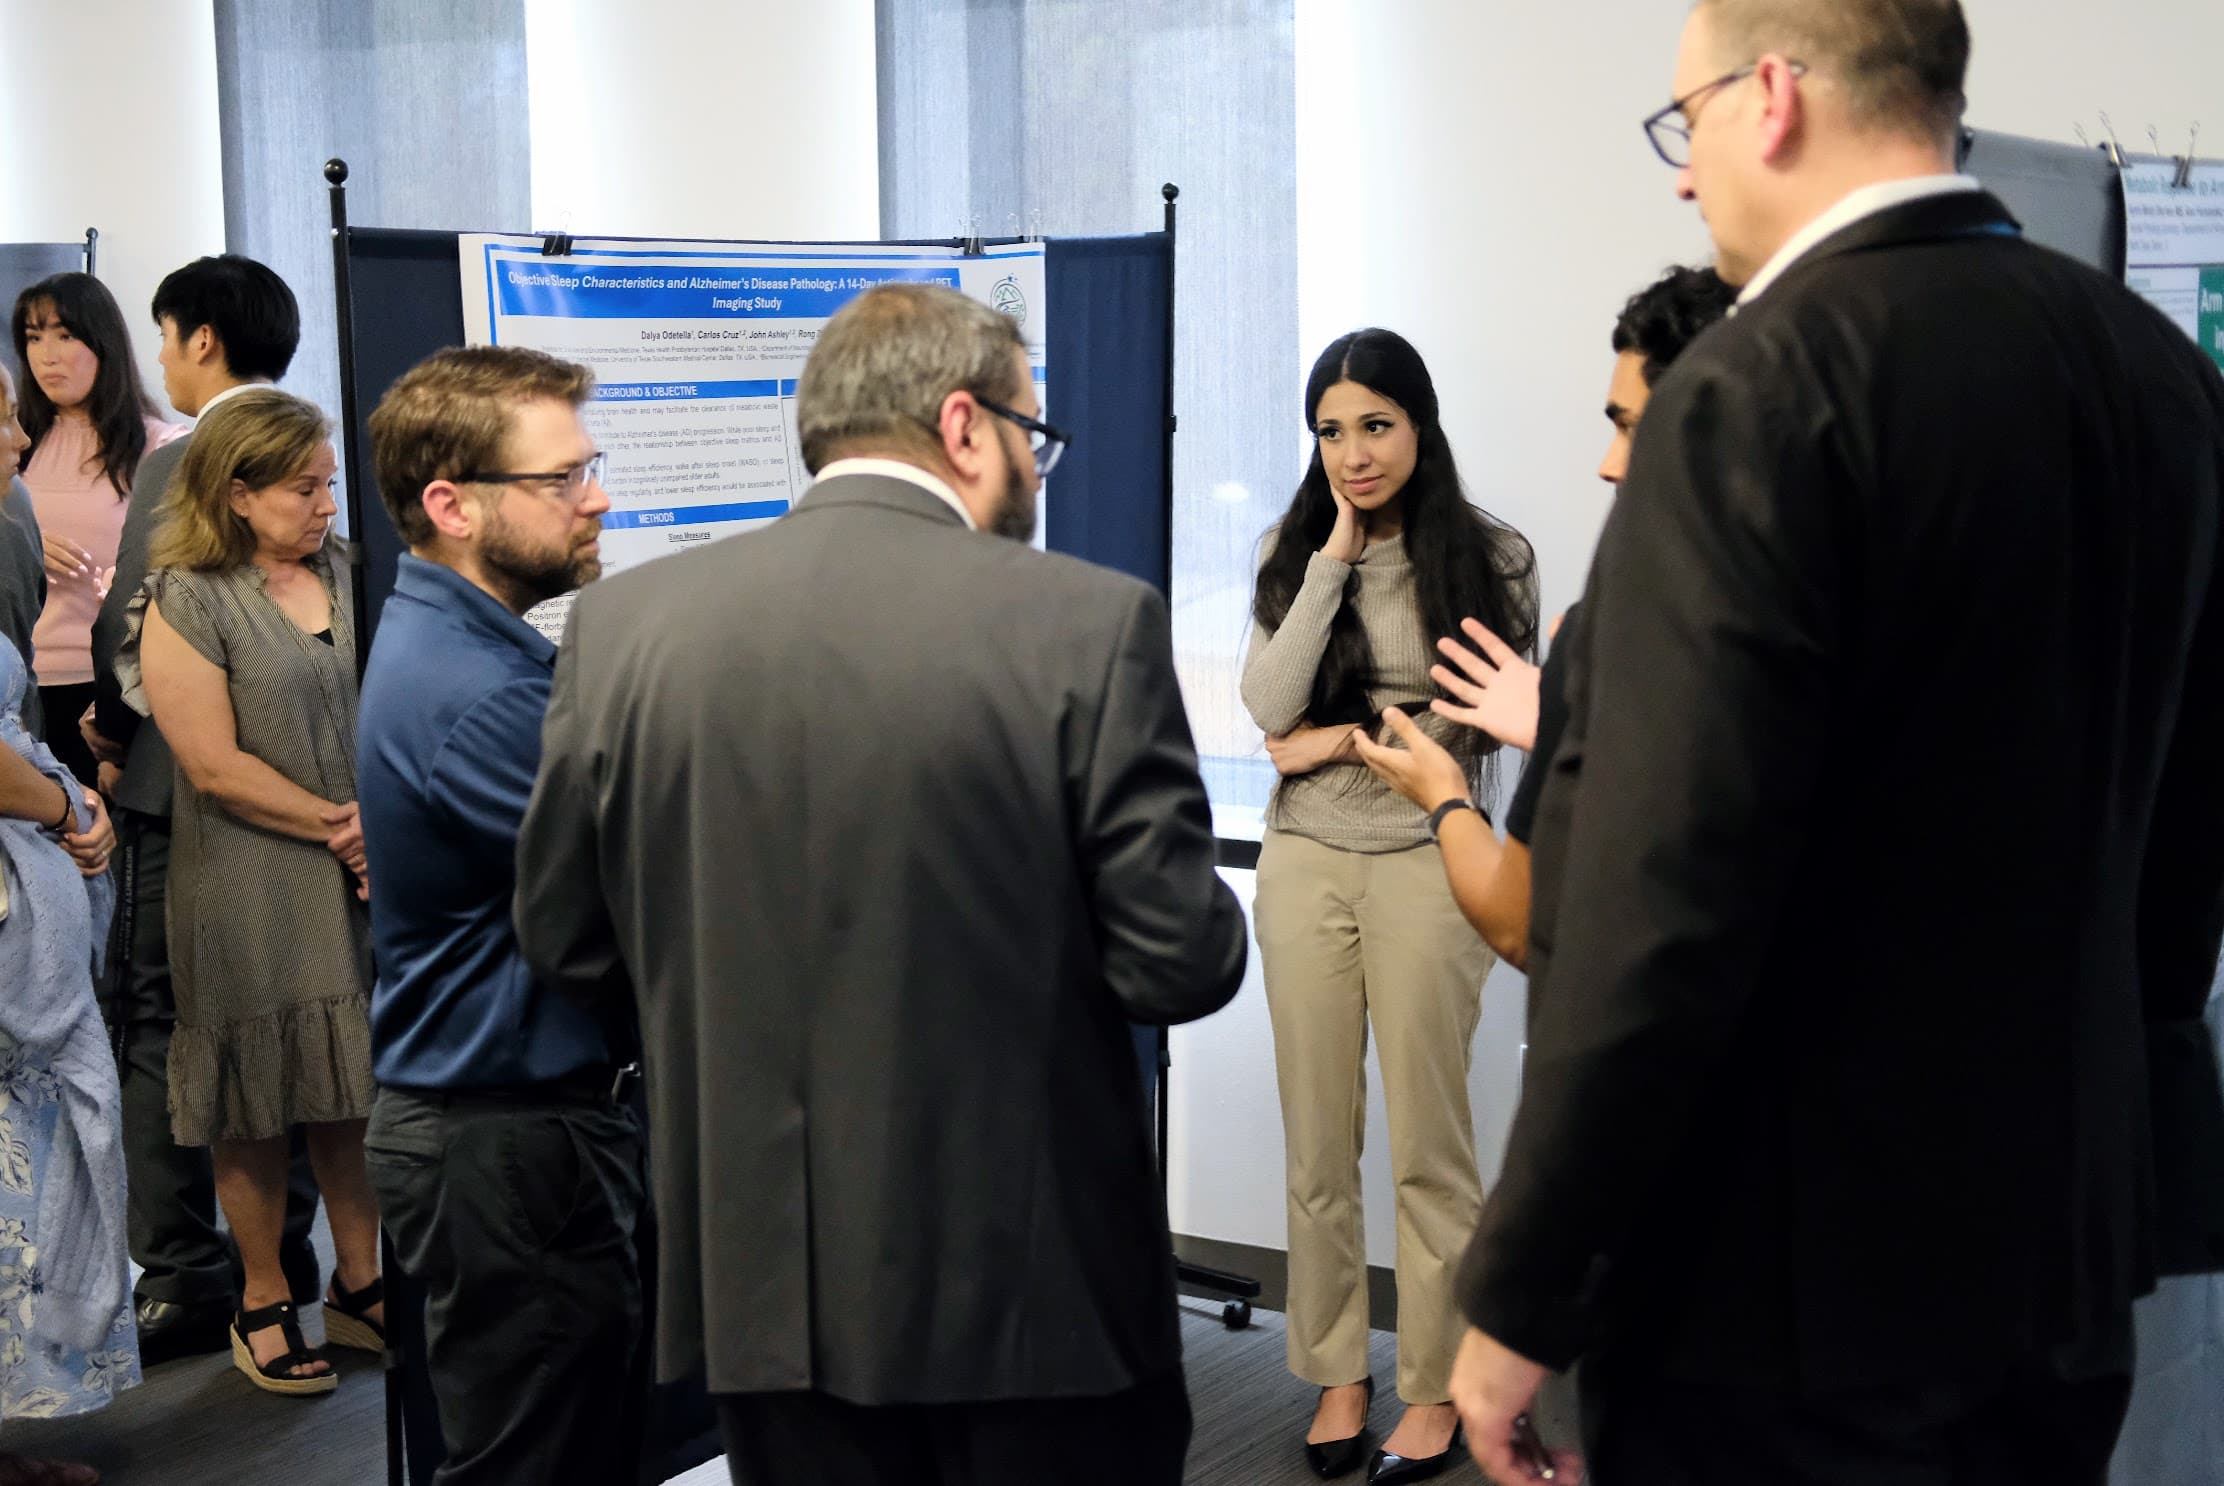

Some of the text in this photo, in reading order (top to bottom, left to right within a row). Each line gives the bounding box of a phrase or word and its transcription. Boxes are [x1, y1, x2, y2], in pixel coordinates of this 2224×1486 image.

[508, 271, 550, 288] Objective
[551, 274, 579, 291] Sleep
[582, 275, 664, 289] Characteristics
[667, 276, 687, 289] and
[689, 277, 749, 289] Alzheimer's
[751, 277, 788, 289] Disease
[790, 278, 837, 292] Pathology:
[839, 278, 845, 289] A
[712, 296, 782, 311] Imaging Study
[641, 330, 660, 341] Dalya
[697, 330, 720, 339] Carlos
[749, 329, 766, 339] John
[798, 329, 815, 339] Rong
[593, 386, 698, 399] ACKGROUND & OBJECTIVE
[638, 511, 674, 525] METHODS
[527, 612, 562, 620] Positron
